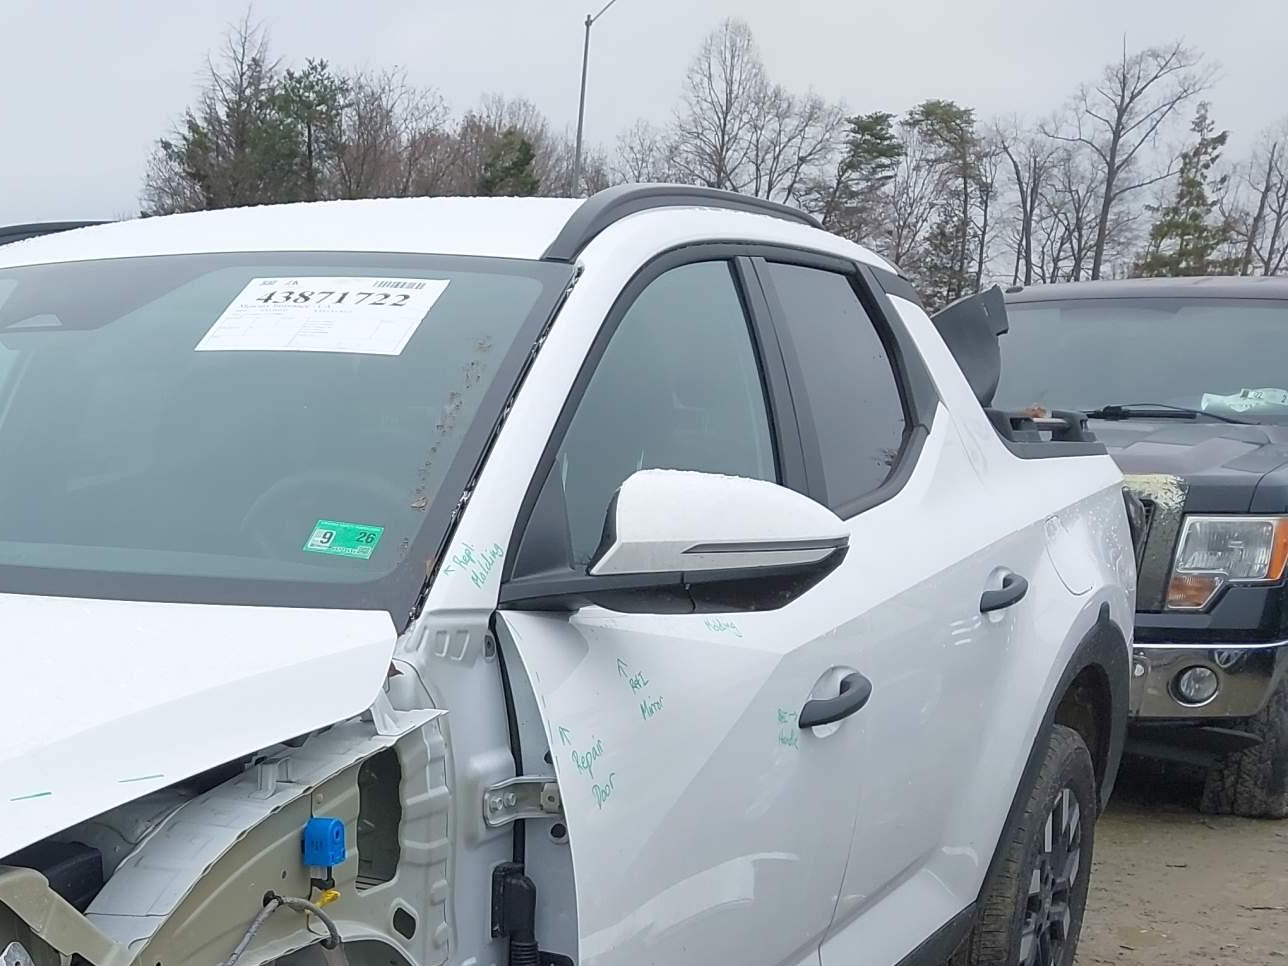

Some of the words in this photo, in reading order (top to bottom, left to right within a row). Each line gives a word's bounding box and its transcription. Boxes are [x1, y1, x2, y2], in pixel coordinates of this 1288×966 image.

[255, 290, 411, 307] 43871722
[320, 531, 333, 545] 9
[357, 531, 377, 544] 26
[572, 735, 603, 780] Repair
[592, 772, 615, 810] Door
